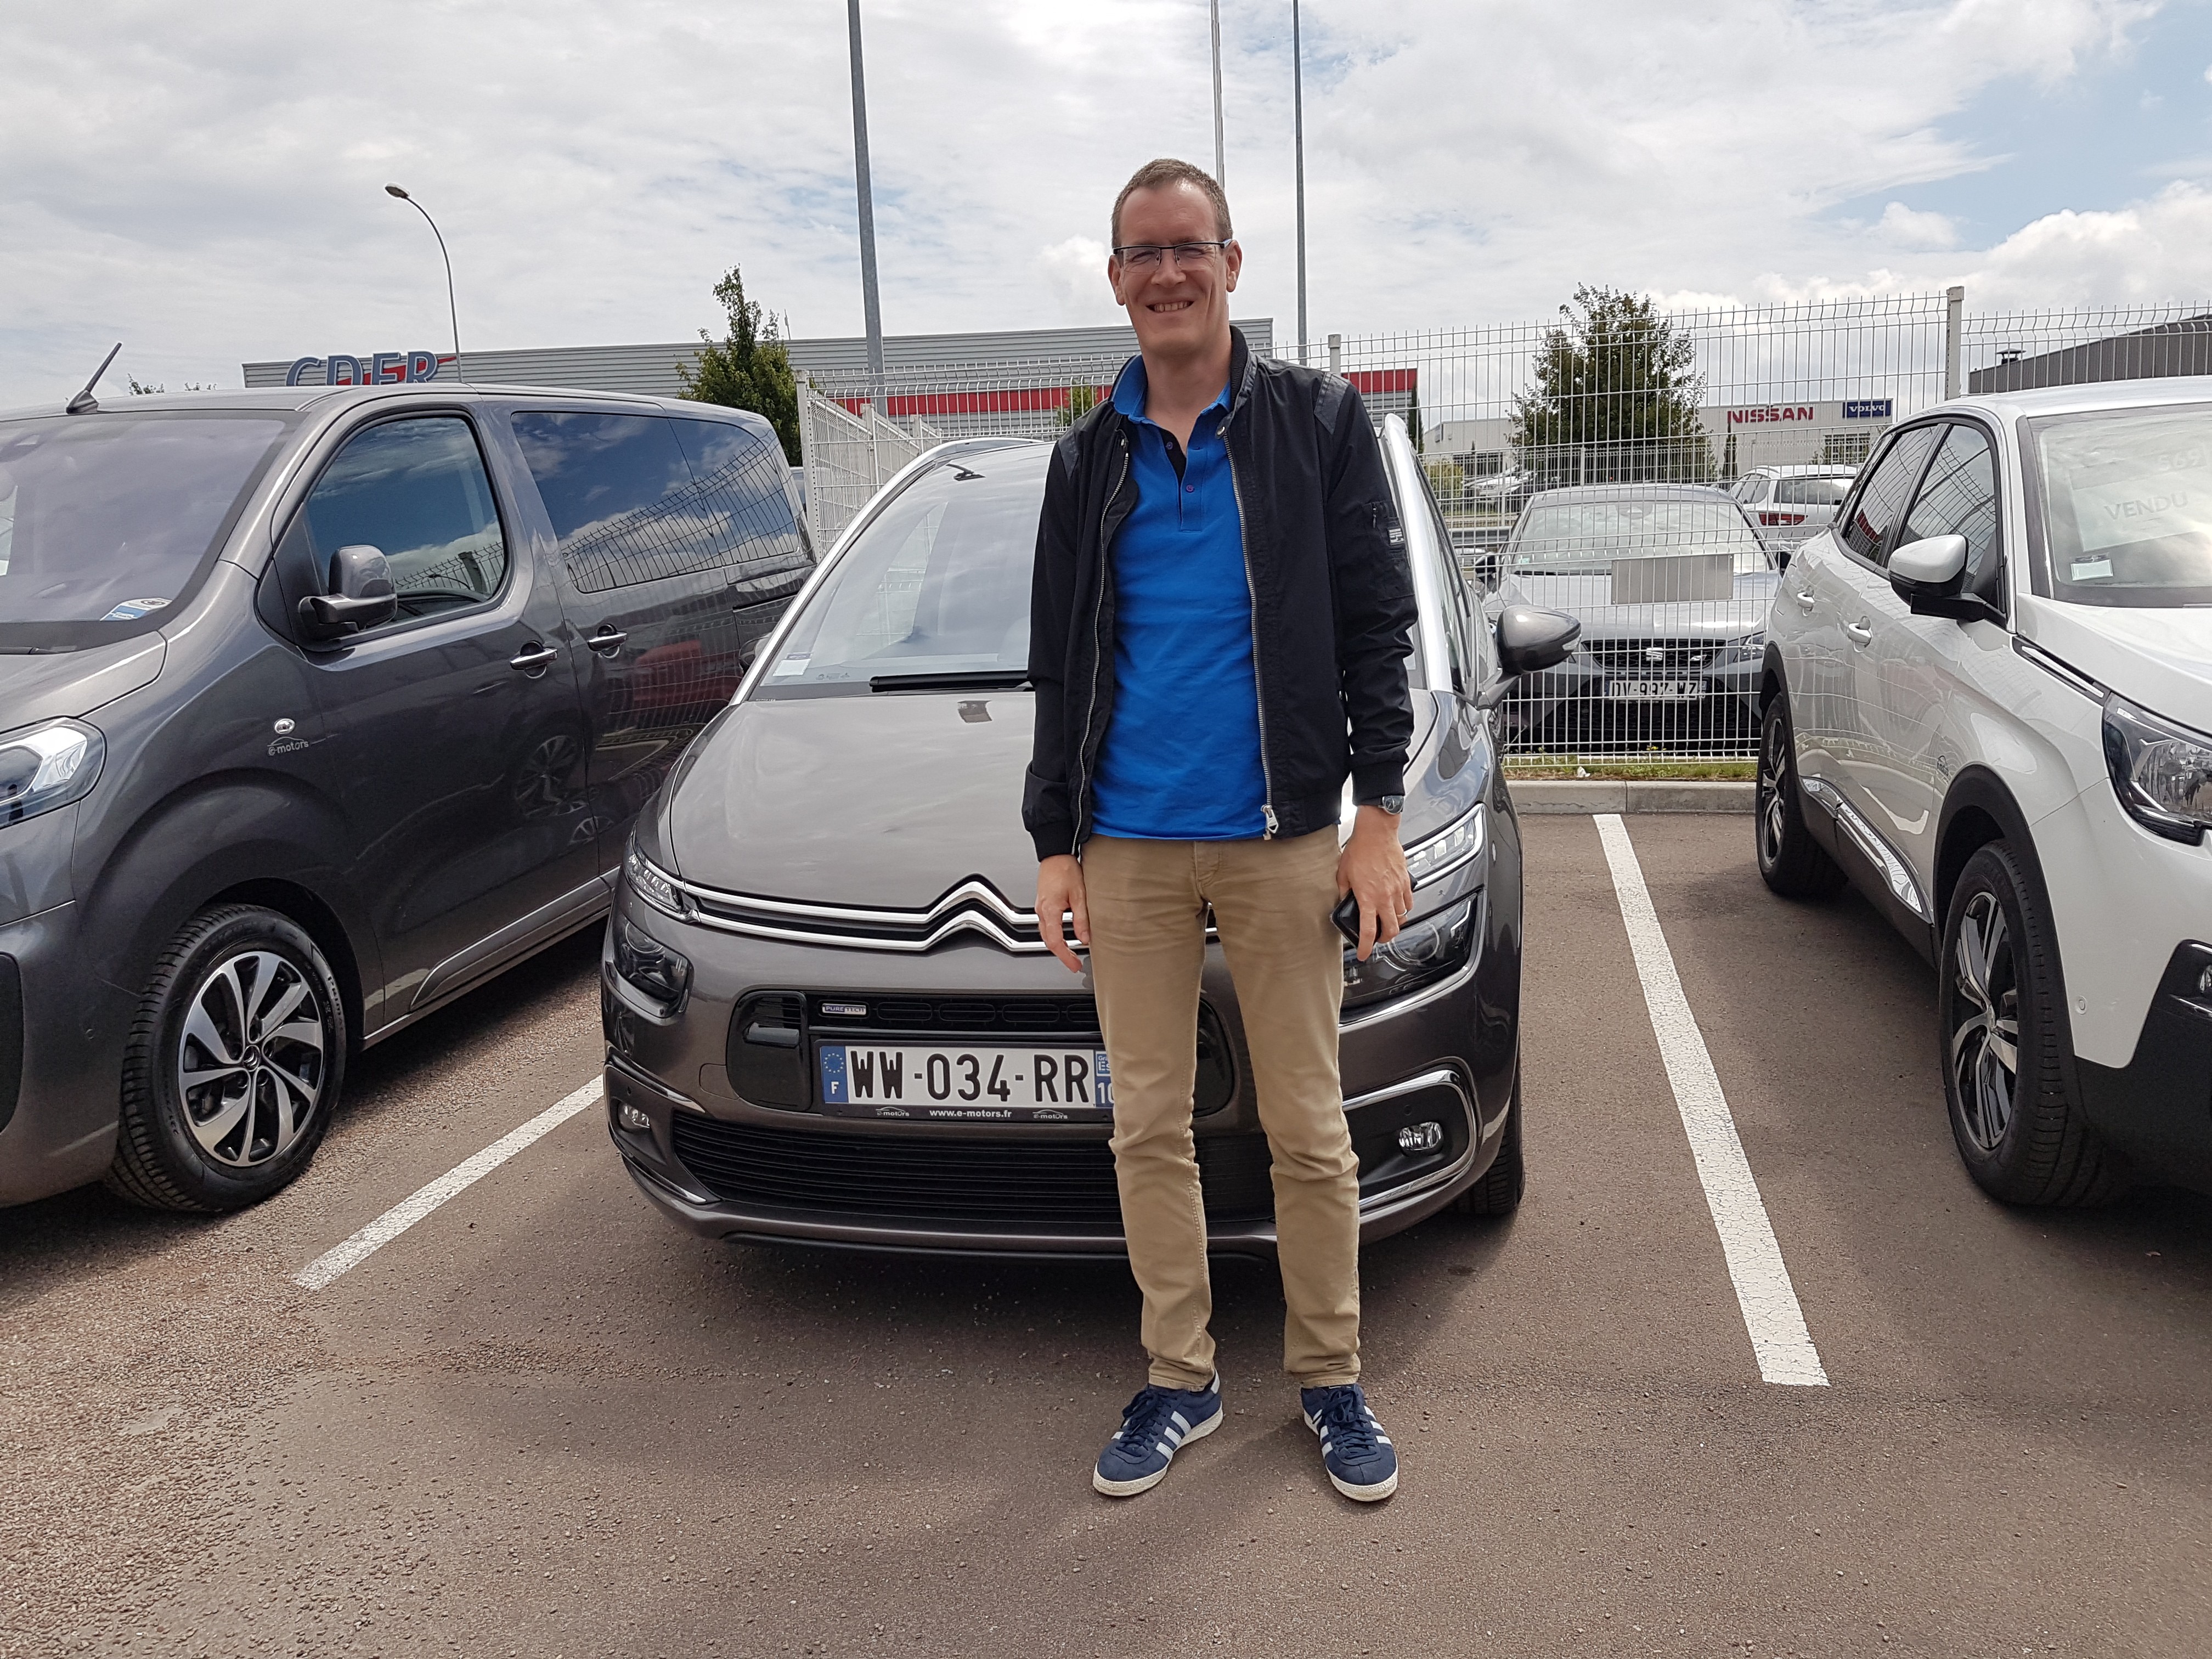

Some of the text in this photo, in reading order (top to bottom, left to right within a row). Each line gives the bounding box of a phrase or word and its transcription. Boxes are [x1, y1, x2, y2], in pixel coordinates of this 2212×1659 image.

[1728, 407, 1813, 424] NISSAN
[1849, 404, 1884, 413] VOLVO
[2103, 491, 2188, 520] VENDU
[850, 1049, 1090, 1104] WW-034-RR
[831, 1081, 839, 1094] F
[929, 1109, 1012, 1119] www.e-motors.fr
